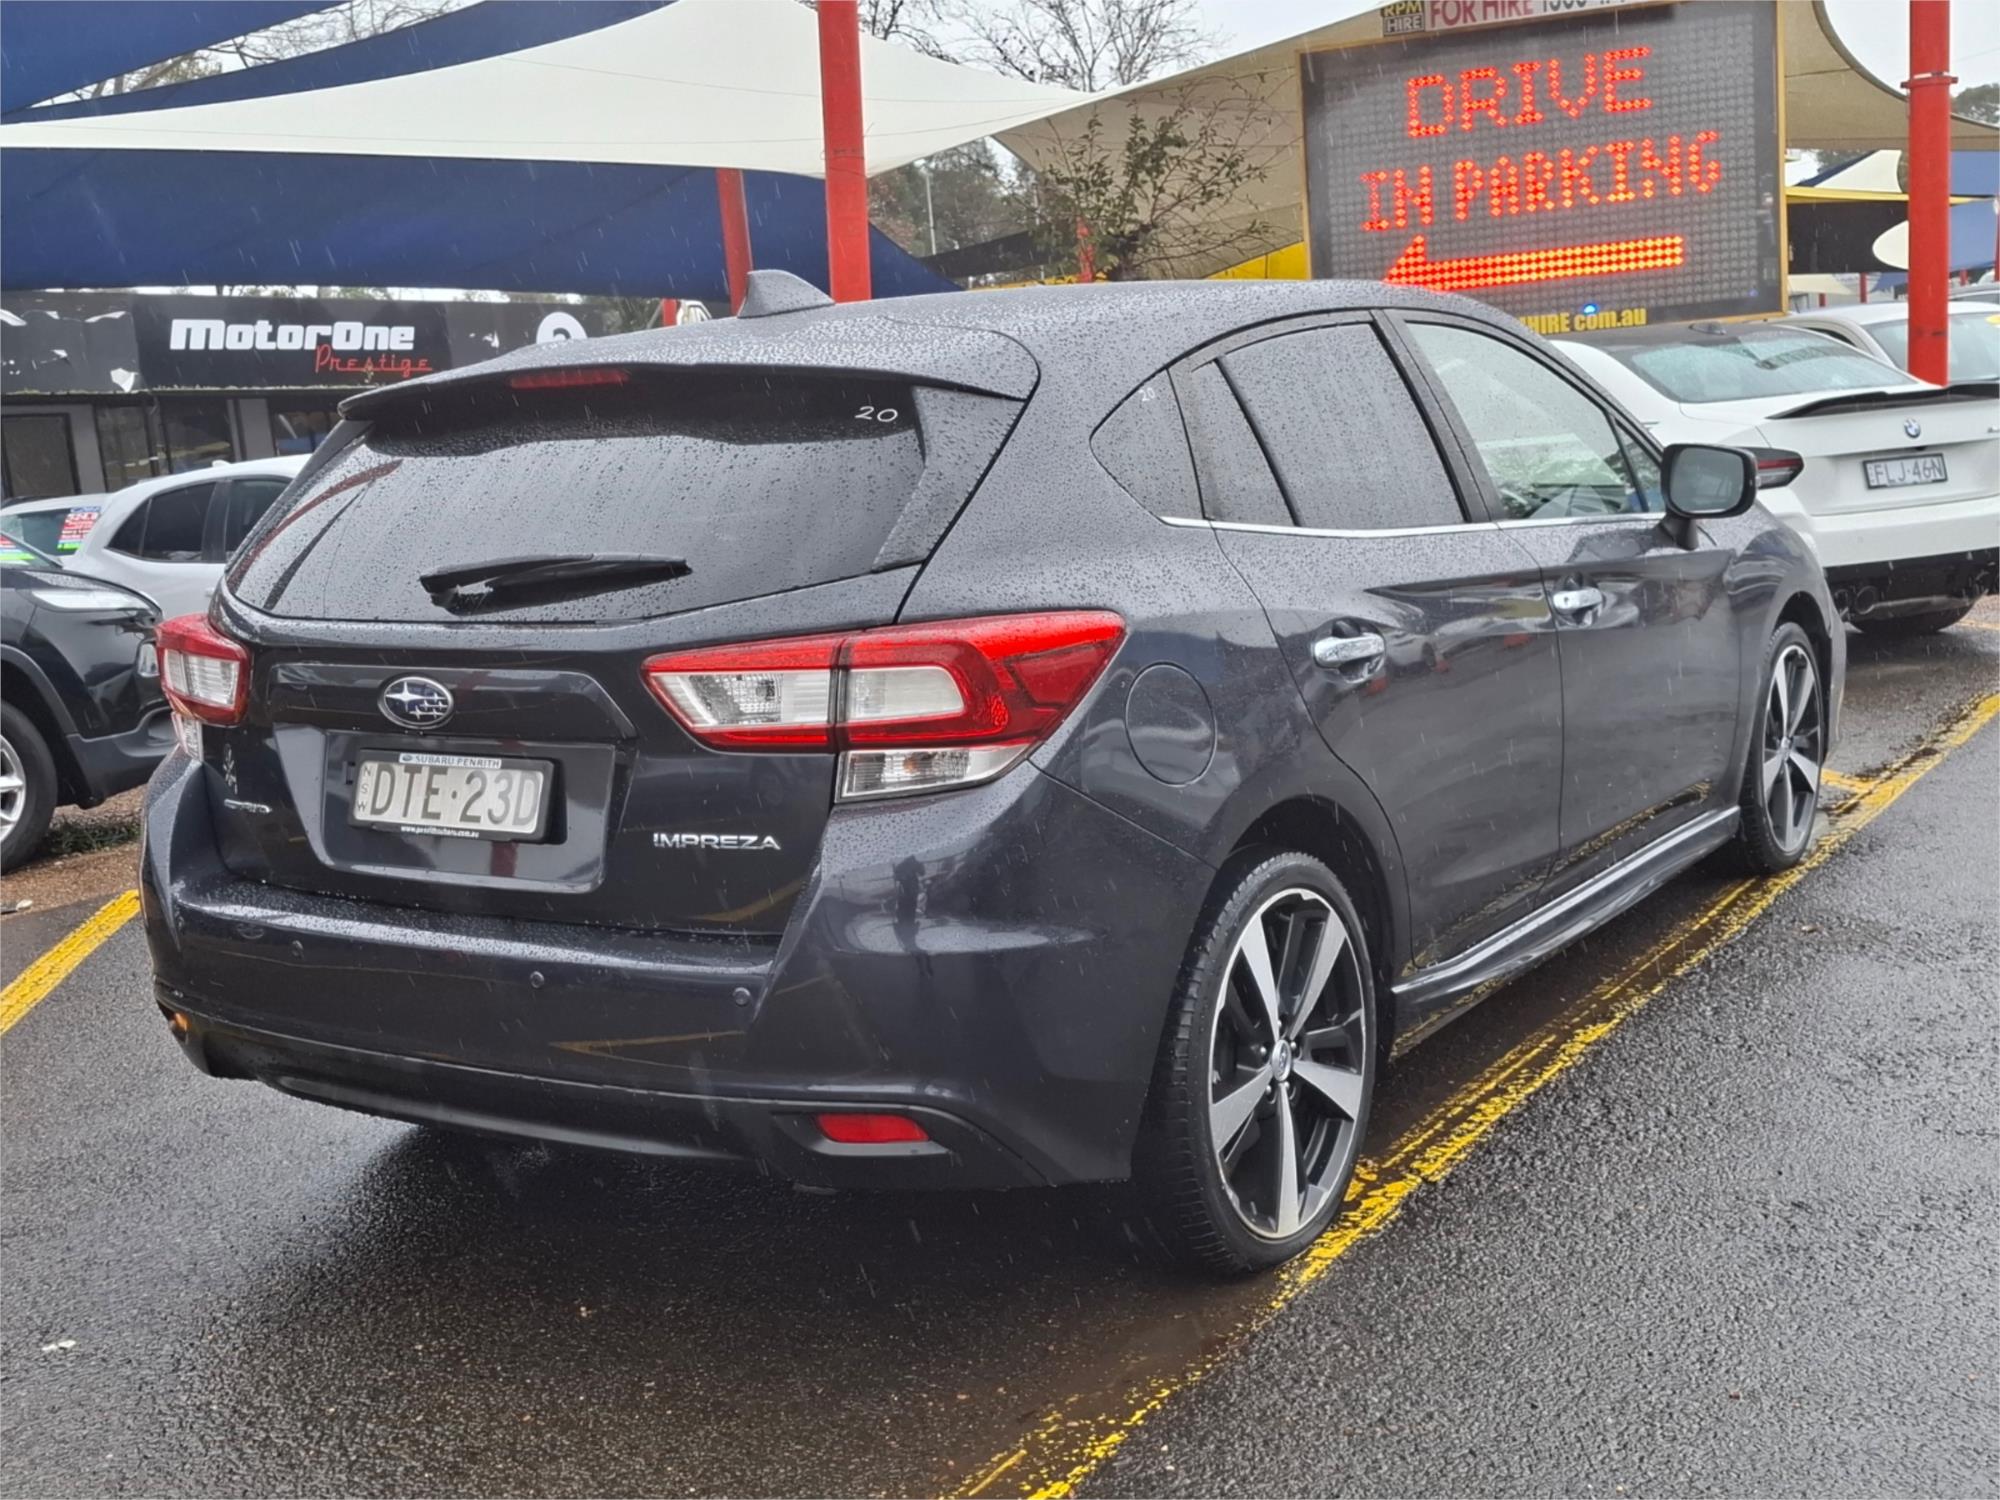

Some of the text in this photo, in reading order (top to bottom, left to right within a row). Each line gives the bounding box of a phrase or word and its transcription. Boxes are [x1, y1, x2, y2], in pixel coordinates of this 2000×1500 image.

[1387, 15, 1421, 32] HIRE
[1430, 0, 1476, 28] FOR
[1407, 46, 1653, 139] DRIVE
[1359, 130, 1722, 233] IN PARKING
[170, 318, 416, 351] MotorOne
[315, 343, 433, 377] Prestige
[854, 405, 899, 422] 20
[415, 755, 500, 768] SUBARU PENRITH
[652, 832, 782, 850] IMPREZA
